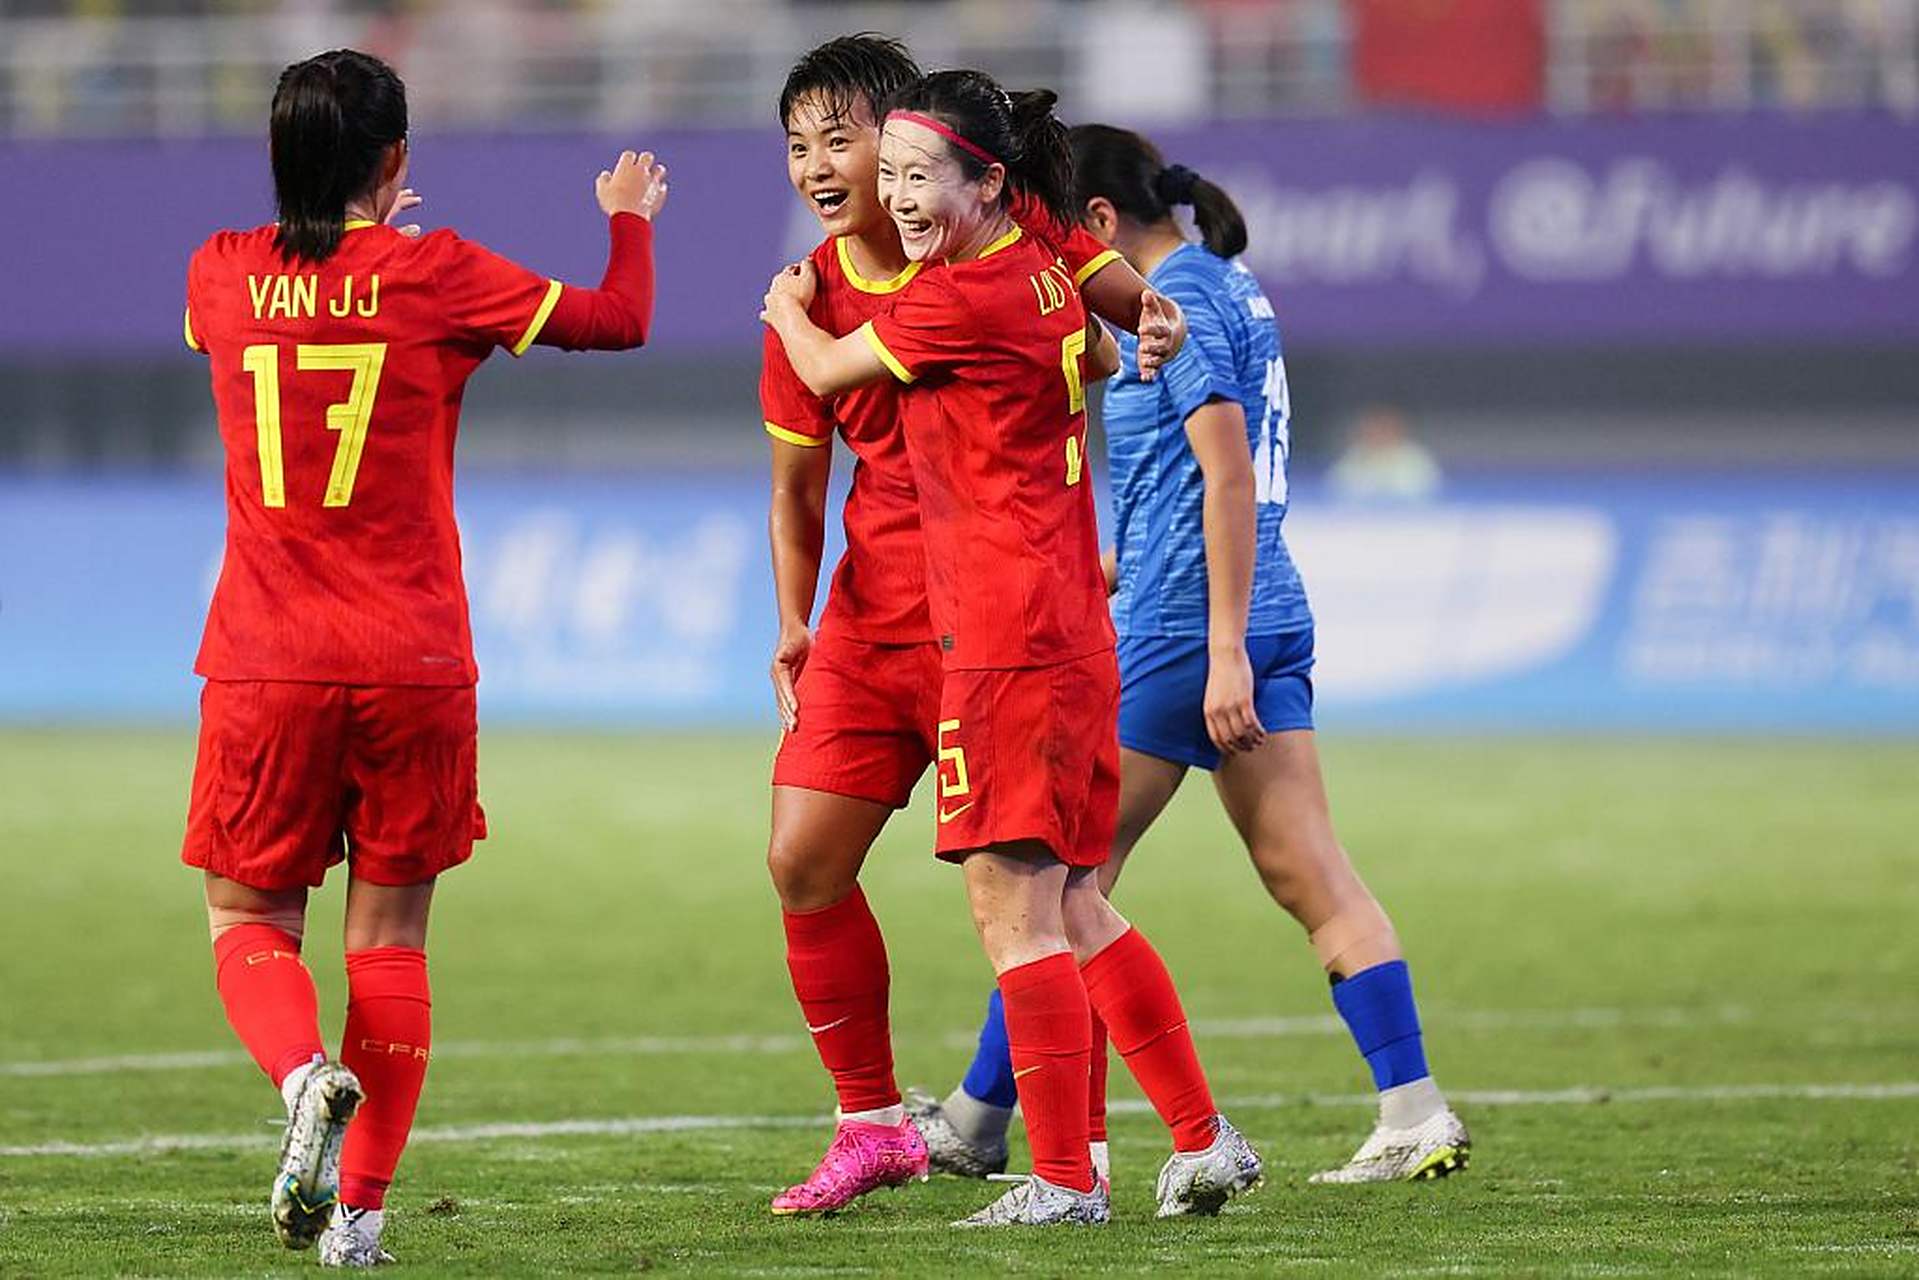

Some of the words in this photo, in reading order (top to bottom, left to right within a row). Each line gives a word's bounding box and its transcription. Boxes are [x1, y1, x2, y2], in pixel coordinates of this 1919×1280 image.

[247, 274, 318, 320] YAN
[329, 274, 380, 317] JJ
[242, 342, 388, 508] 17
[937, 718, 970, 799] 5
